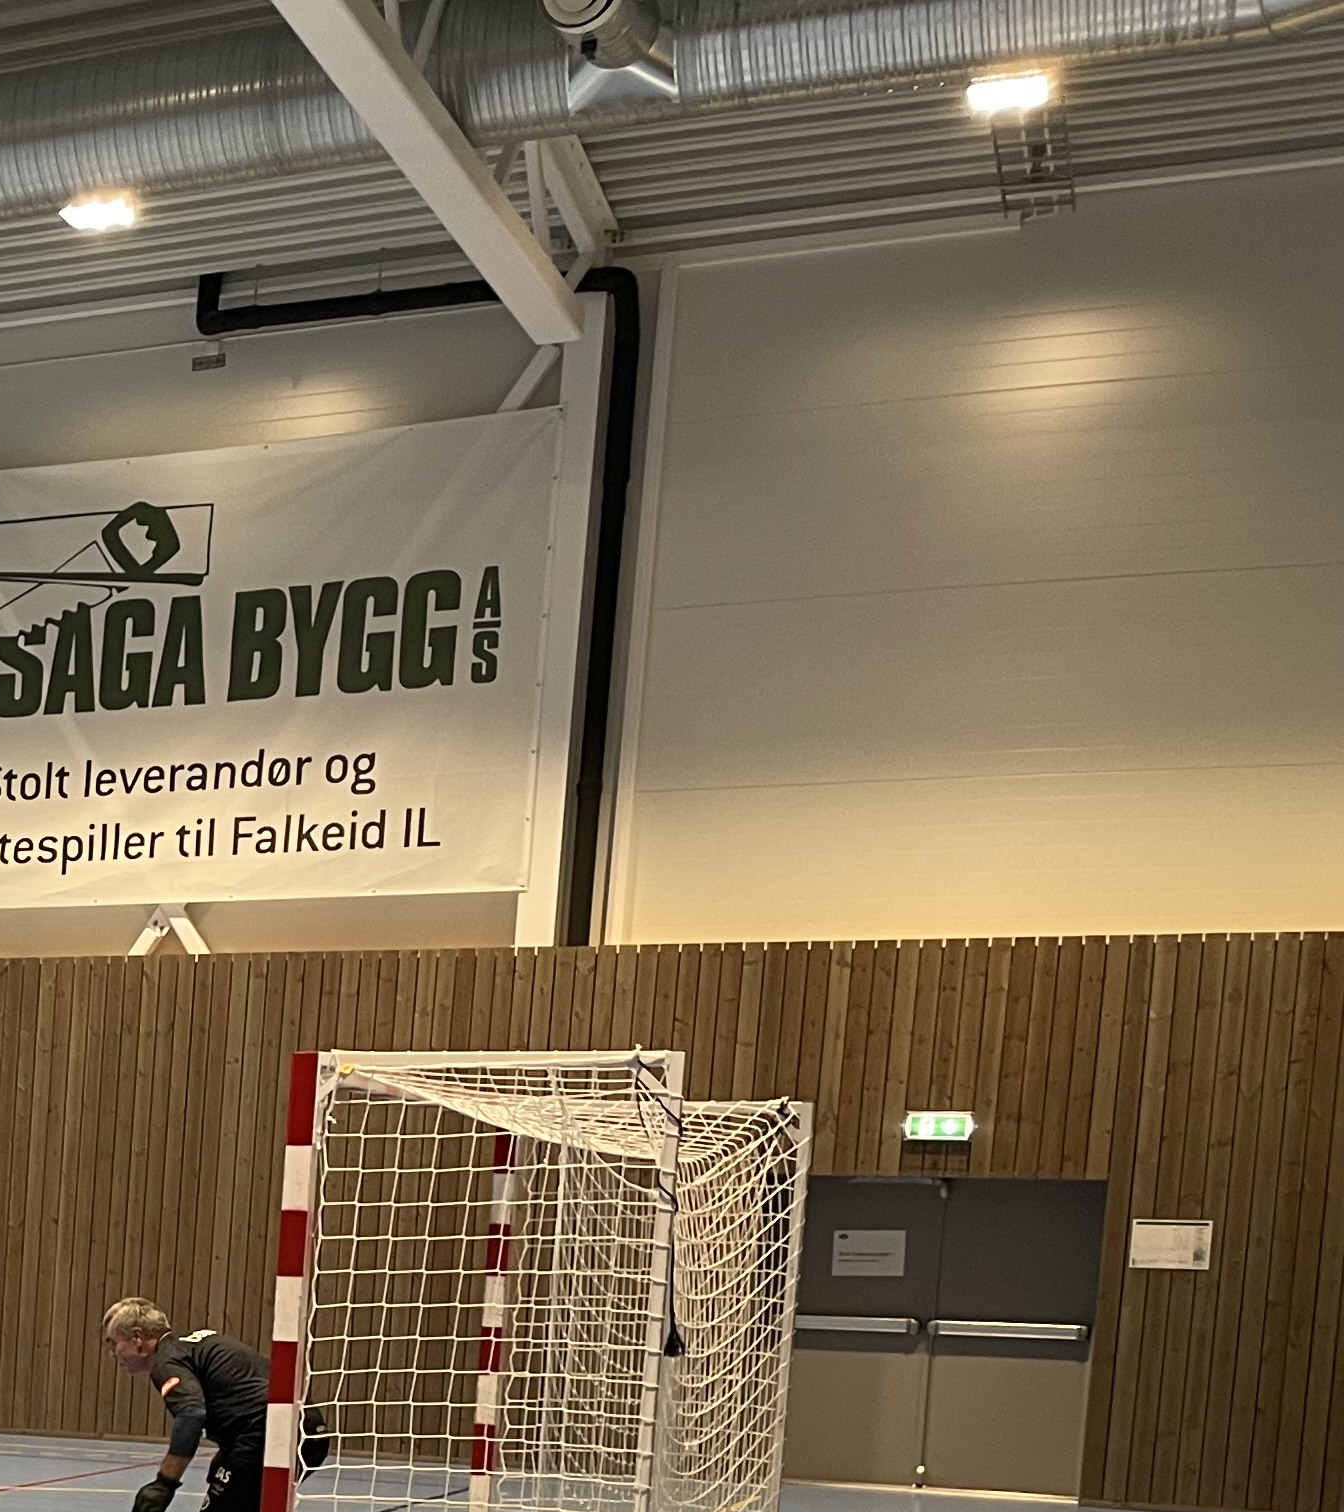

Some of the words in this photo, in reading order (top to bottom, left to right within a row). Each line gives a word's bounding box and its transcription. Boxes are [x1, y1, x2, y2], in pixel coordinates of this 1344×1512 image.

[226, 569, 462, 703] BYGG
[83, 748, 314, 798] leverandør
[324, 751, 377, 796] og
[175, 819, 216, 858] til
[231, 809, 387, 857] Falkeid
[404, 807, 441, 849] IL
